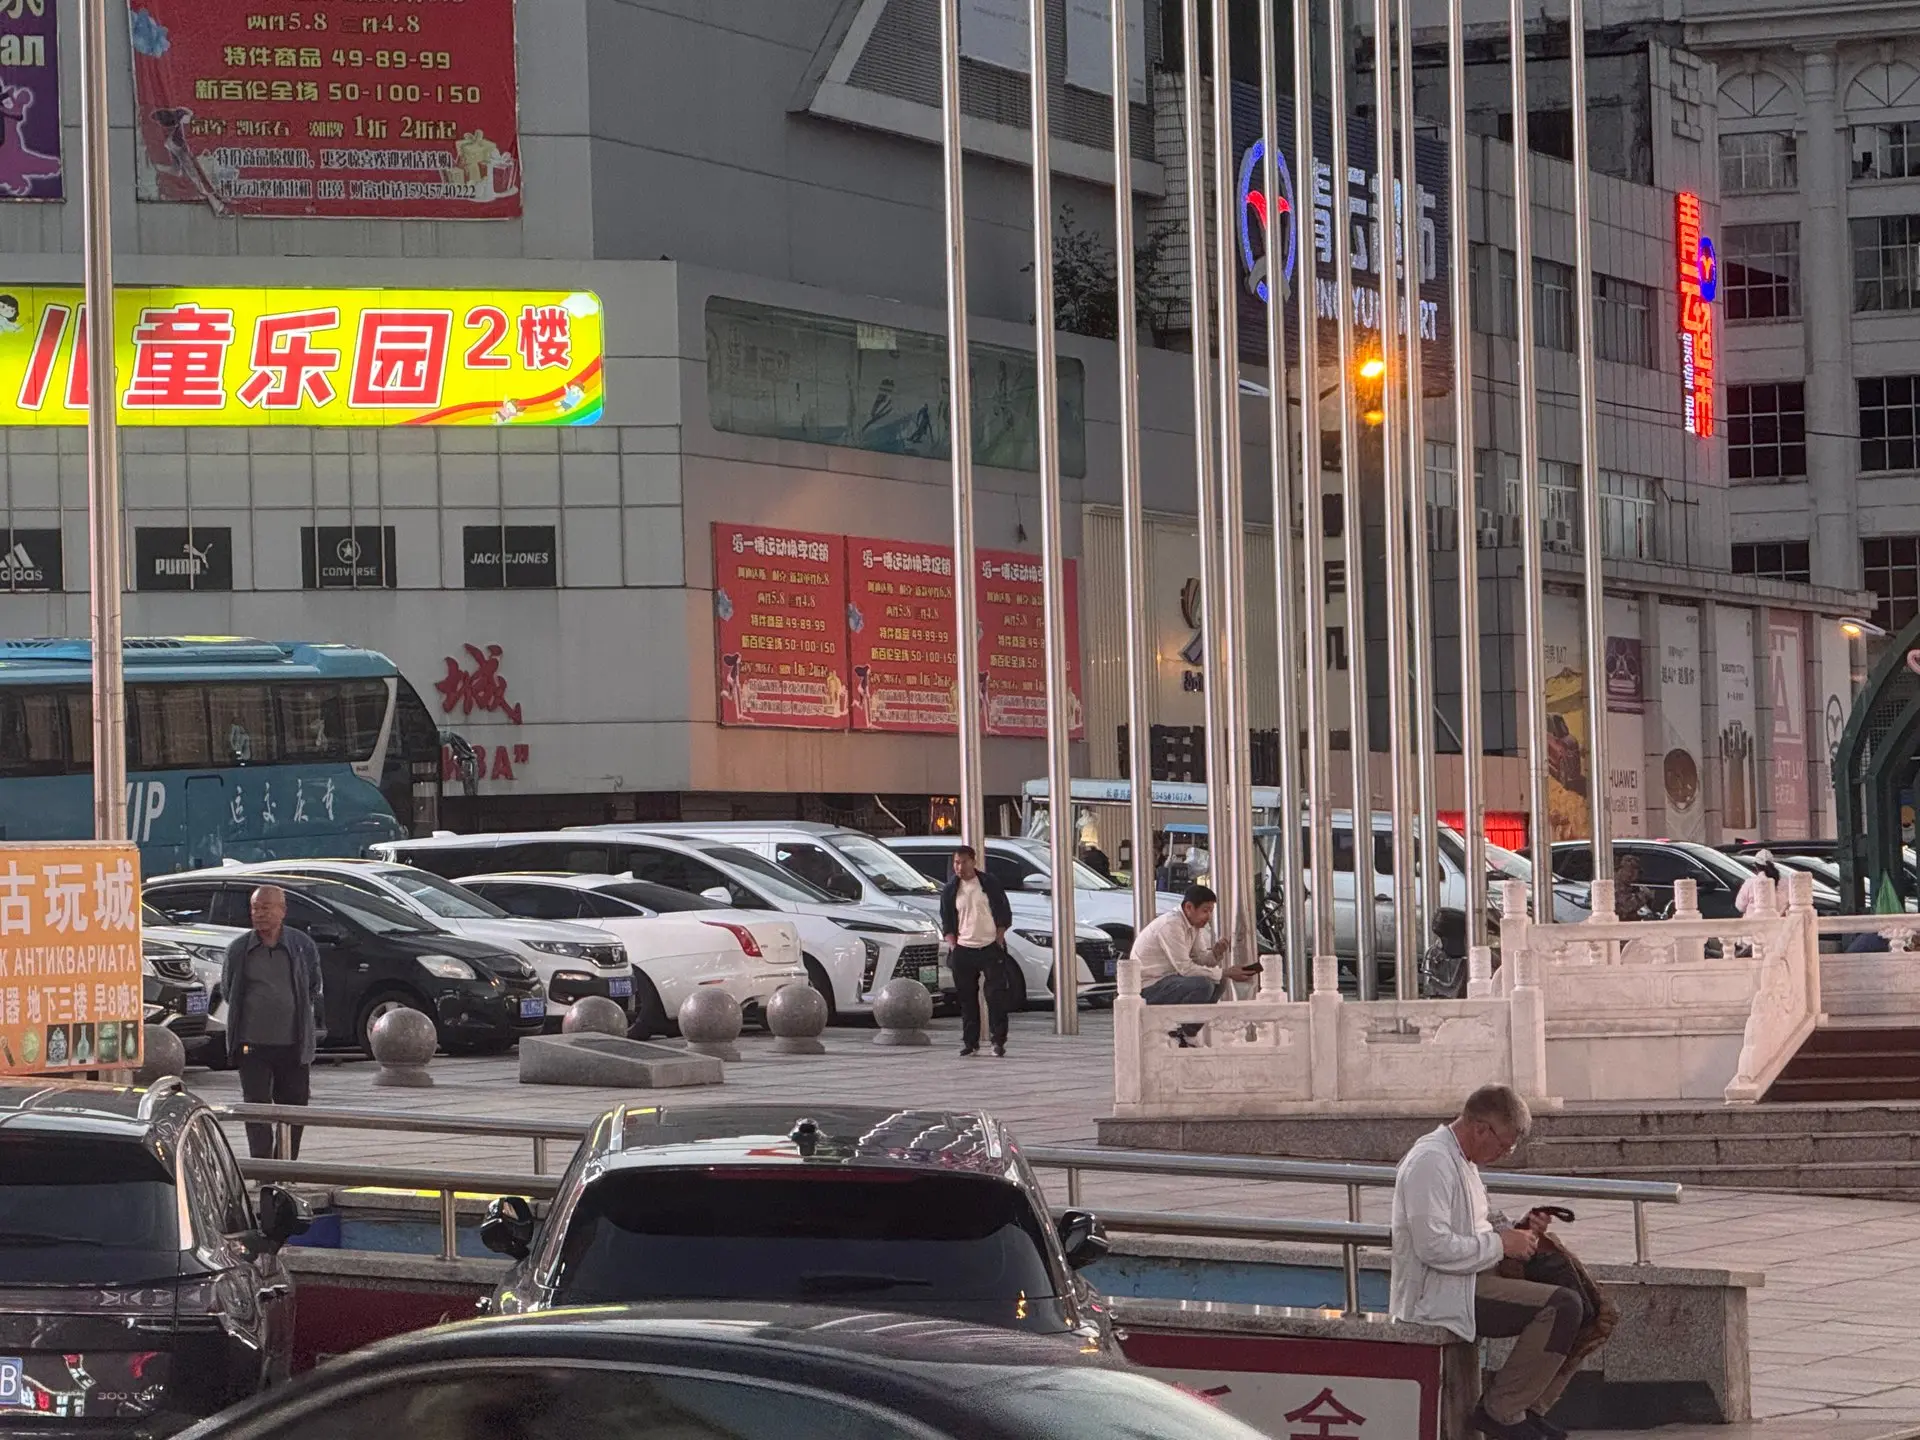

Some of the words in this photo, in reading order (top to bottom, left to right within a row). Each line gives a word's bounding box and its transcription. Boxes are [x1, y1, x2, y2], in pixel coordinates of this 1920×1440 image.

[224, 46, 322, 68] 特件商品
[332, 50, 451, 69] 49-89-99
[195, 79, 318, 101] 新百伦全场
[328, 82, 481, 104] 50-100-150
[155, 558, 202, 576] PUMA
[322, 566, 377, 578] CONVRSE
[785, 616, 826, 632] 49-89-99
[911, 628, 949, 643] 49-89-99
[785, 639, 836, 655] 50-100-150
[0, 858, 136, 937] 古玩城
[14, 944, 137, 976] АНТИКВАРИАТА
[97, 1391, 127, 1401] 300
